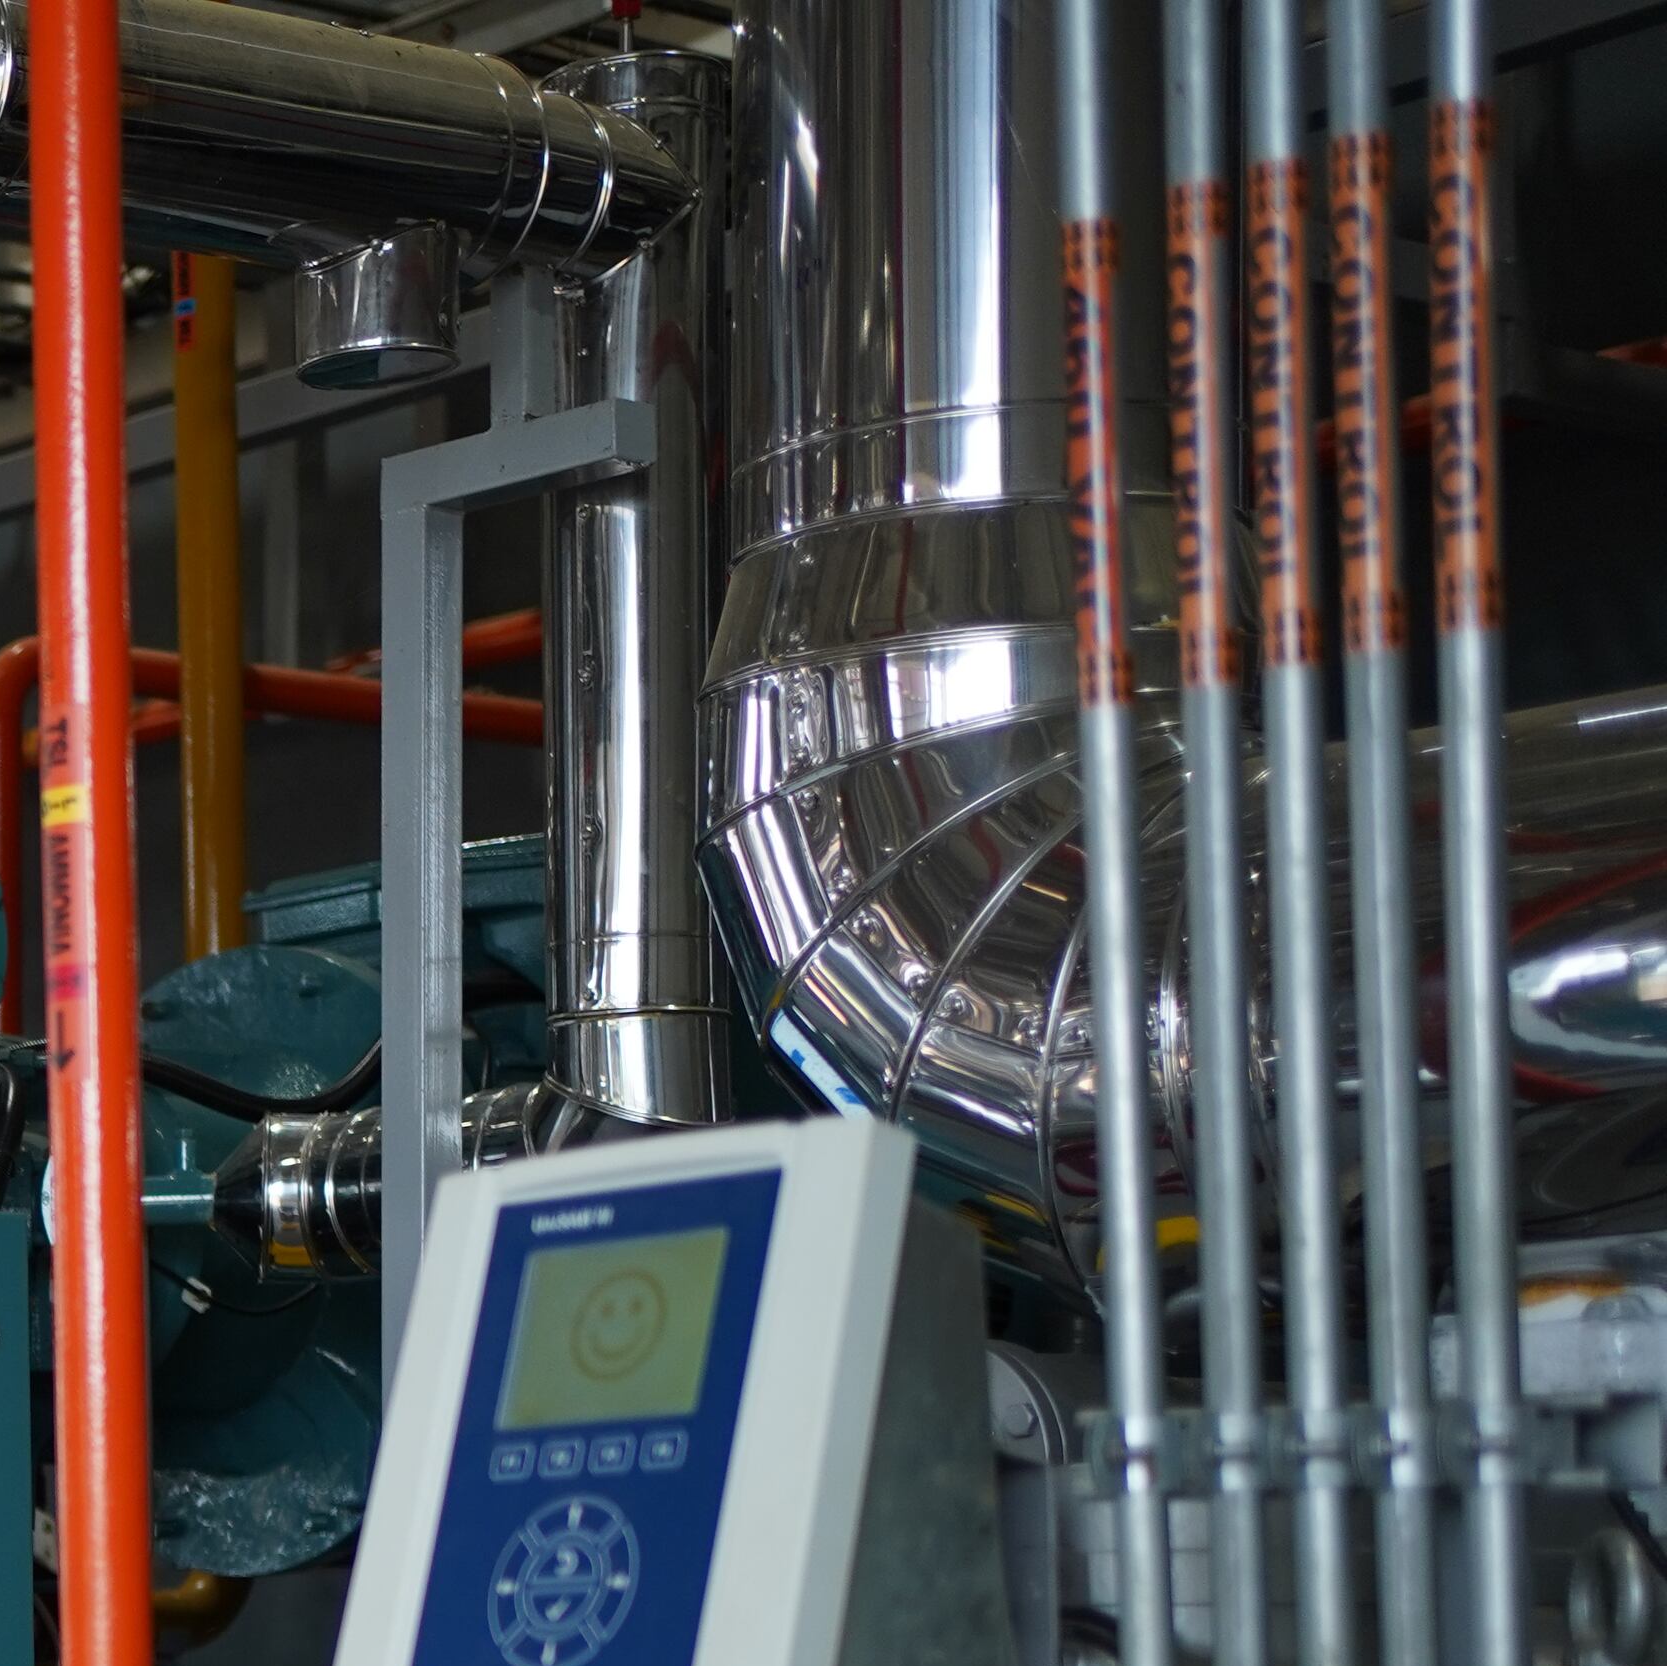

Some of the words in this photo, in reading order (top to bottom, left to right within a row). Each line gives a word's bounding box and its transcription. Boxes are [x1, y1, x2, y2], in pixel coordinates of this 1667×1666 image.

[1251, 226, 1295, 581] CONTROL
[1332, 203, 1376, 562] CONTROL
[1431, 173, 1482, 560] CONTROL
